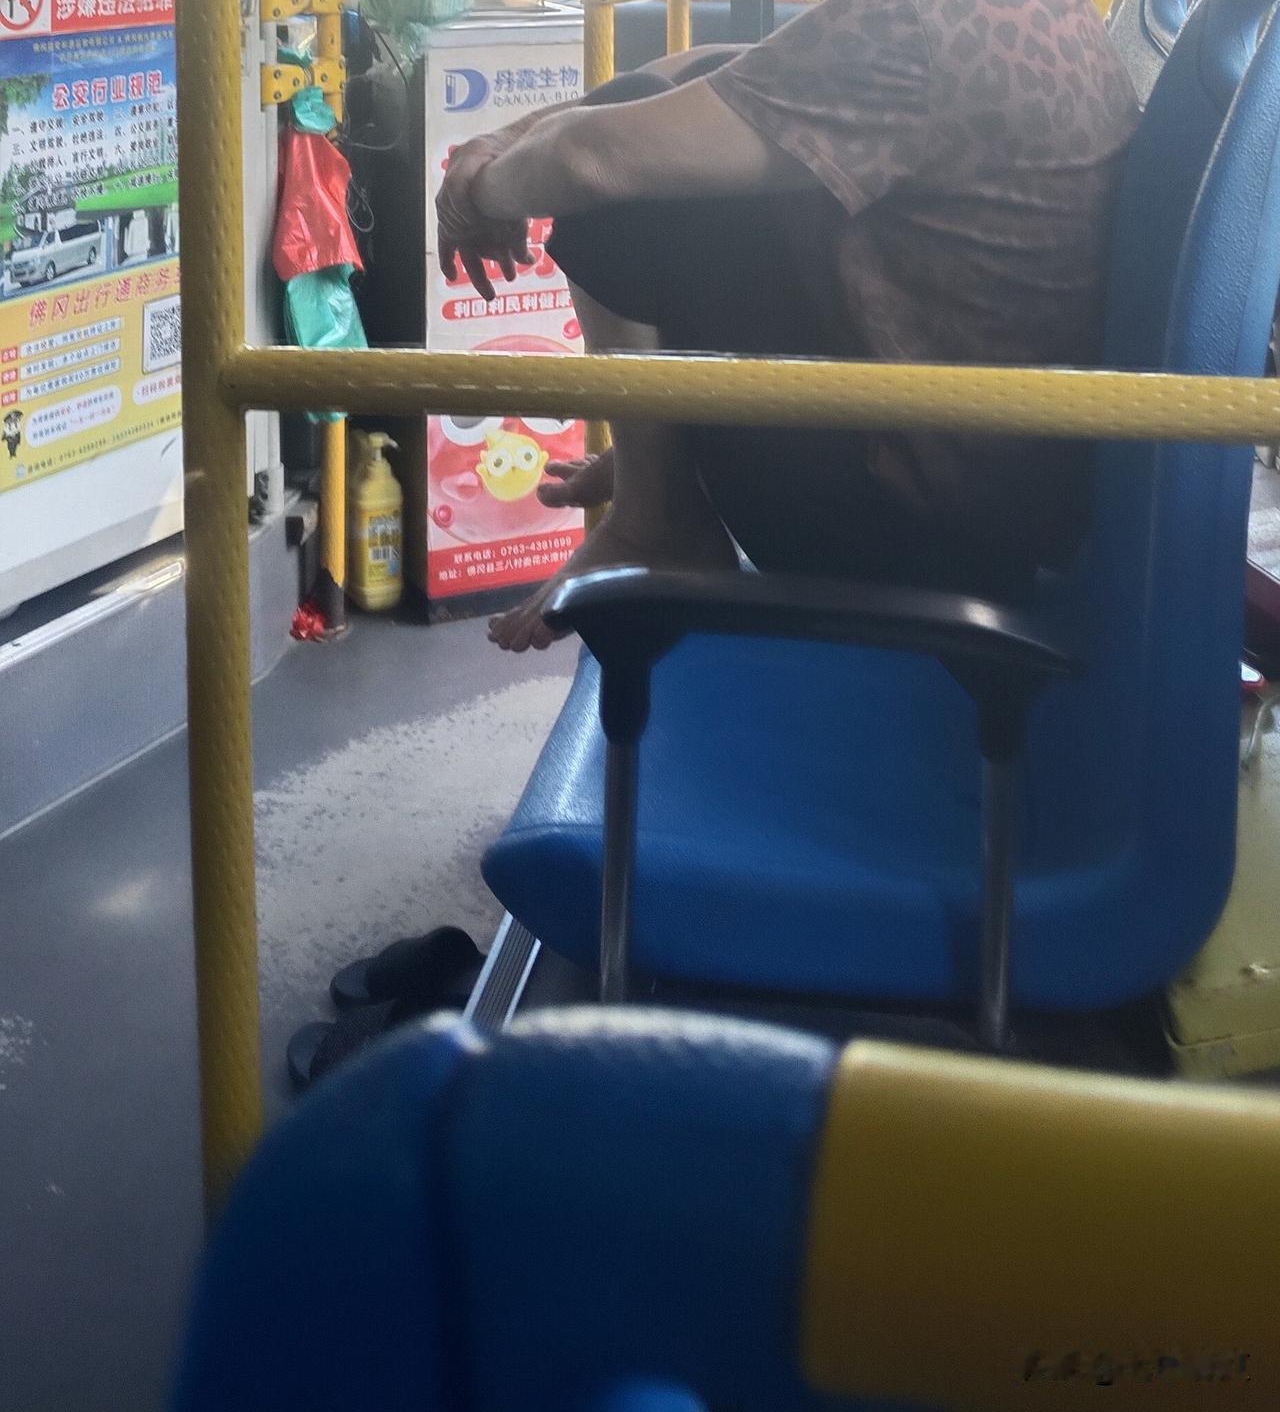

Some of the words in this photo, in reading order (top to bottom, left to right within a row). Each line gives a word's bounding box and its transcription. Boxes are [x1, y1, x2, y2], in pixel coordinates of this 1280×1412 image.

[54, 70, 162, 110] 公交行业规范
[495, 66, 579, 92] 丹霞生物
